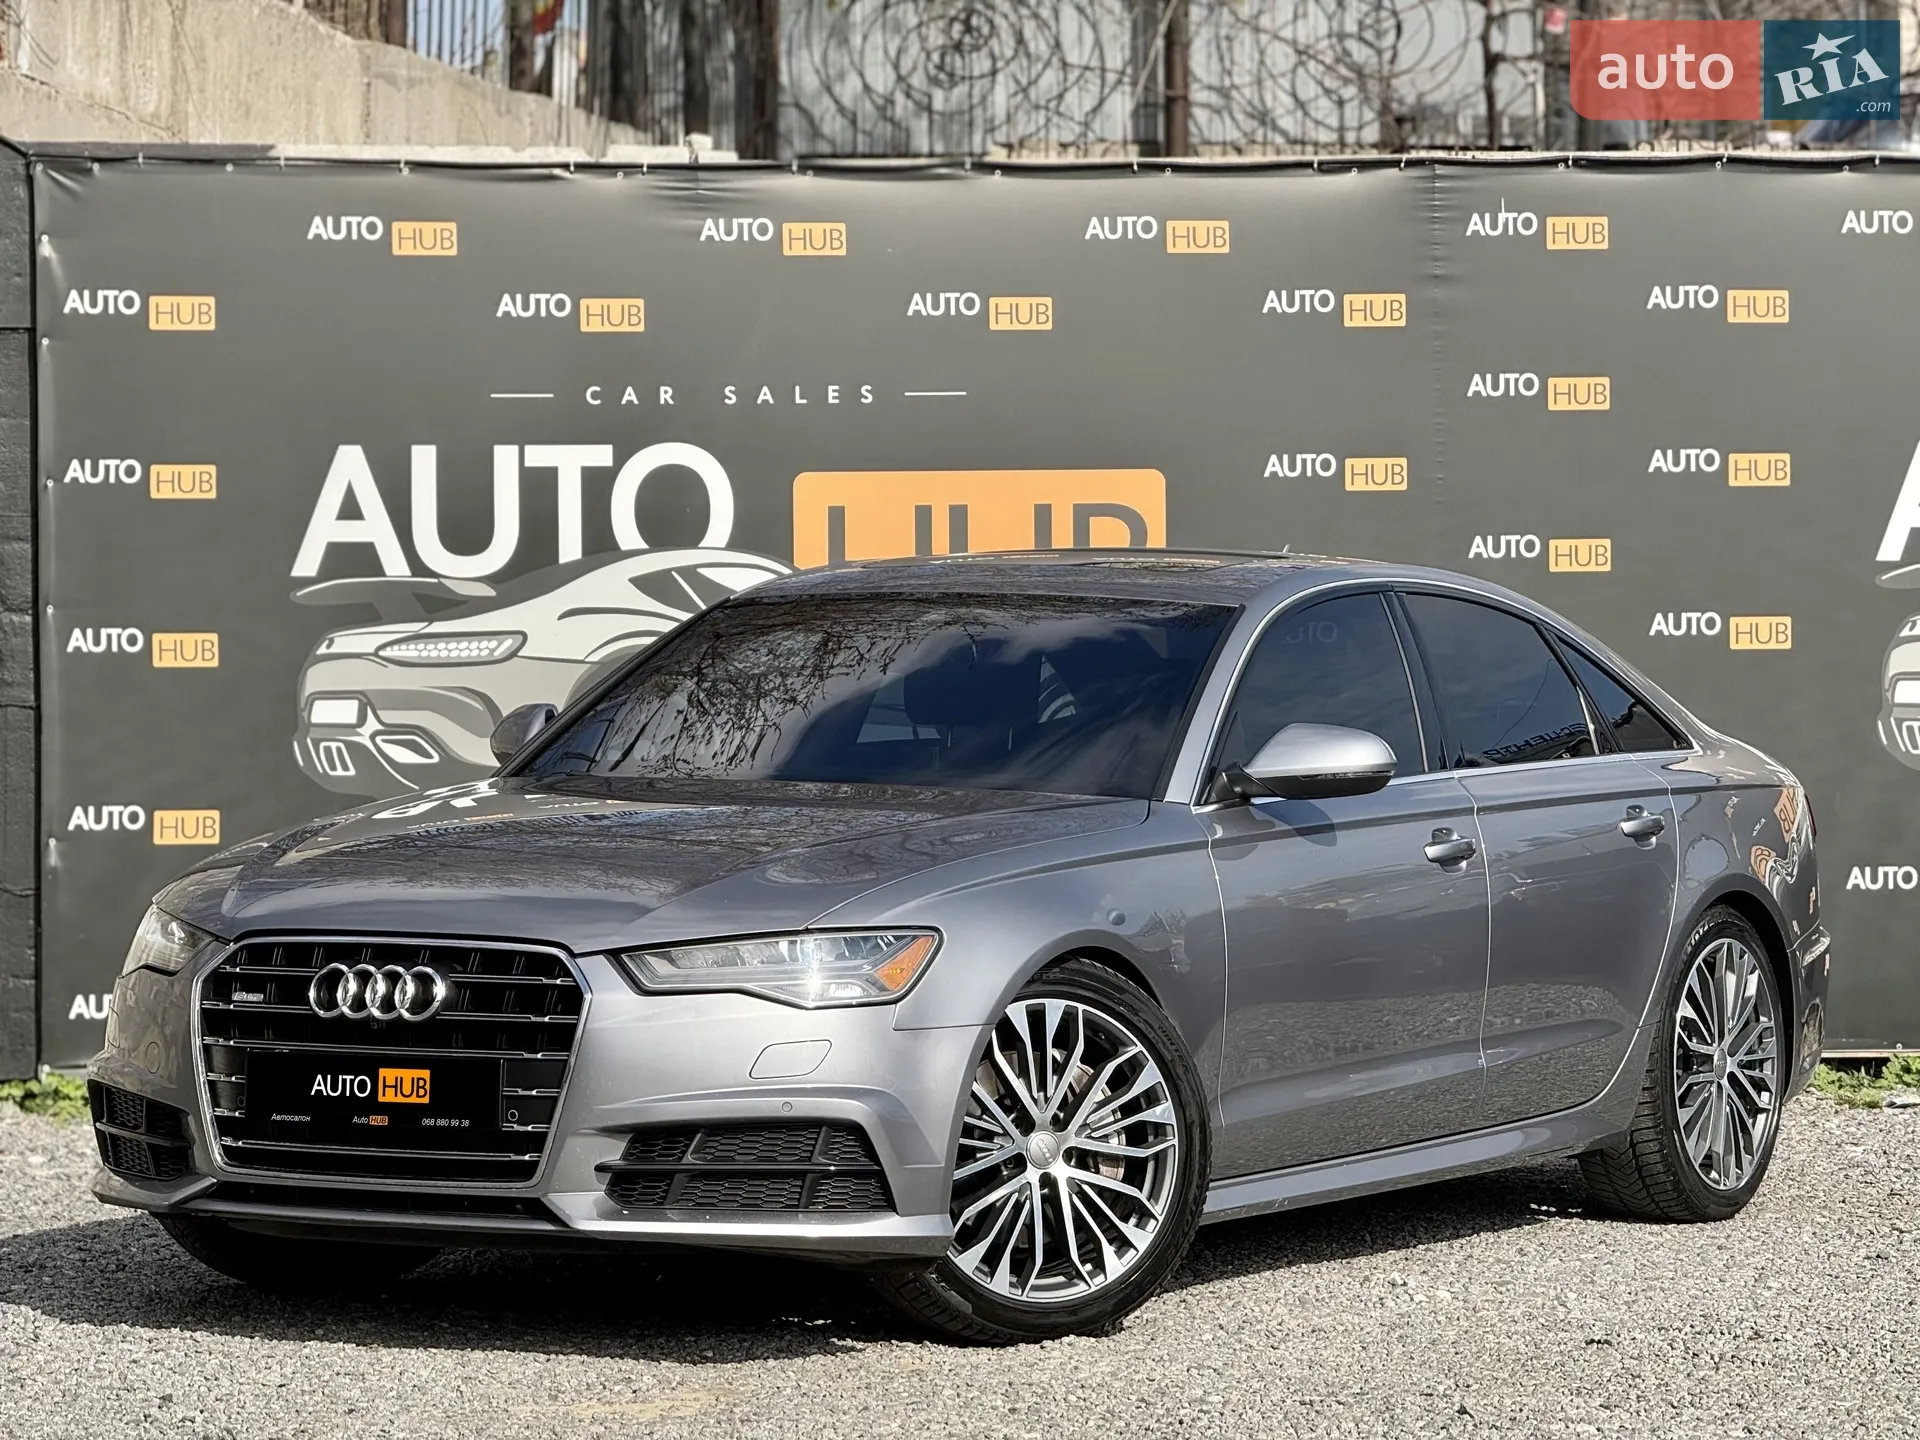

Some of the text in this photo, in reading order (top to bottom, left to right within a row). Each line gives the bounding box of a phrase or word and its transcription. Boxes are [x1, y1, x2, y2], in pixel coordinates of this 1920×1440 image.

[307, 216, 454, 250] AUTO HUB
[700, 218, 844, 251] AUTO HUB
[1085, 216, 1227, 249] AUTO HUB
[1466, 213, 1605, 245] AUTO HUB
[1841, 210, 1913, 234] AUTO
[63, 289, 212, 325] AUTO HUB
[496, 293, 642, 327] AUTO HUB
[907, 292, 1050, 325] AUTO HUB
[1262, 289, 1404, 322] AUTO HUB
[1647, 285, 1786, 318] AUTO HUB
[585, 384, 874, 405] CAR SALES
[1467, 373, 1607, 405] AUTO HUB
[64, 459, 213, 494] AUTO HUB
[1264, 453, 1405, 486] AUTO HUB
[1648, 449, 1788, 481] AUTO HUB
[291, 442, 735, 577] AUTO
[1468, 535, 1609, 567] AUTO HUB
[67, 628, 216, 662] AUTO HUB
[1649, 612, 1789, 645] AUTO HUB
[68, 805, 217, 839] AUTO HUB
[1846, 866, 1918, 889] AUTO
[68, 994, 113, 1020] AU
[311, 1074, 428, 1098] AUTO HUB
[352, 1116, 387, 1124] Auto HUB
[421, 1118, 470, 1127] 068 880 99 38
